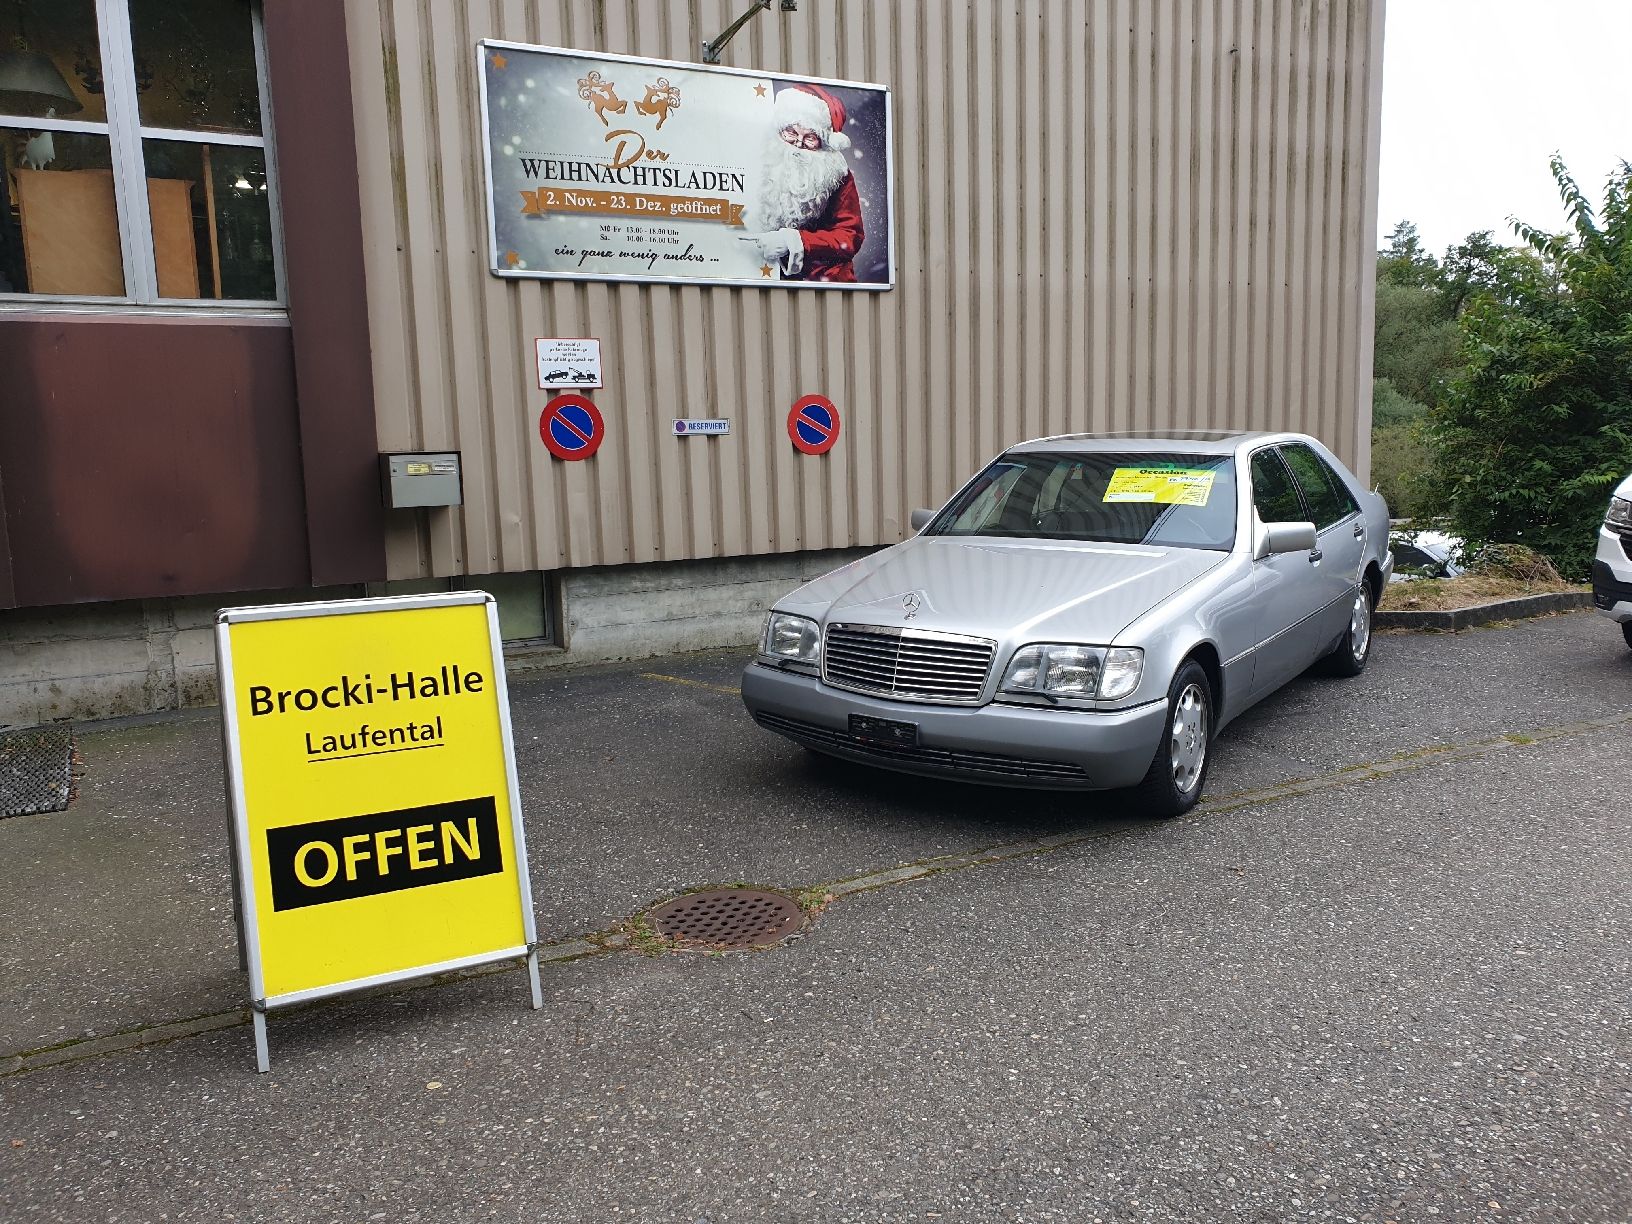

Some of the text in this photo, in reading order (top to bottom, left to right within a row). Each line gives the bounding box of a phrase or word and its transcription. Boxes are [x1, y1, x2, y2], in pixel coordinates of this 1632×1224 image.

[600, 129, 670, 169] Der
[519, 158, 745, 193] WEIHNACHTSLADEN
[546, 192, 560, 206] 2.
[564, 193, 597, 207] Nov.
[610, 196, 631, 209] 23.
[634, 197, 666, 211] Dez.
[670, 200, 721, 215] geöffnet
[600, 233, 610, 241] Sa.
[667, 237, 680, 245] Uhr
[554, 245, 576, 256] ein
[578, 250, 615, 267] ganz
[619, 249, 660, 270] wenig
[663, 244, 705, 263] anders
[688, 422, 727, 431] RESERVIERT
[250, 664, 484, 717] Brocki-Halle
[305, 716, 443, 755] Laufental
[293, 817, 482, 888] OFFEN
